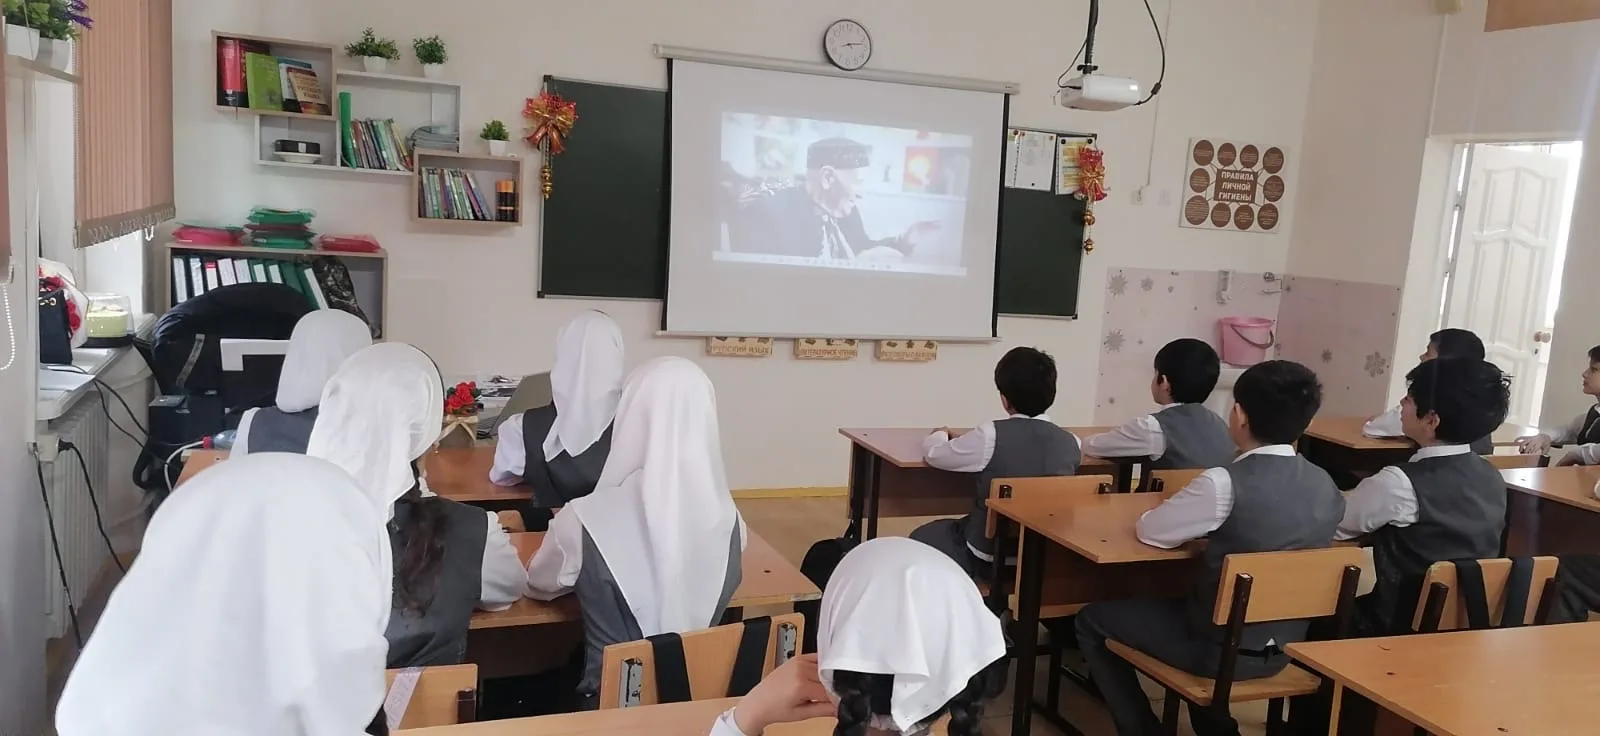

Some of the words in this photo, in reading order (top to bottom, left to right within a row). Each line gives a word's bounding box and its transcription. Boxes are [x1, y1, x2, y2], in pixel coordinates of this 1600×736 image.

[1221, 171, 1255, 181] ПРАВИЛА
[1222, 181, 1251, 191] ЛИЧНОЙ
[1218, 191, 1252, 201] ГИГИЕНЫ
[712, 343, 747, 354] РУССКИЙ
[748, 344, 769, 355] ЯЗЫК
